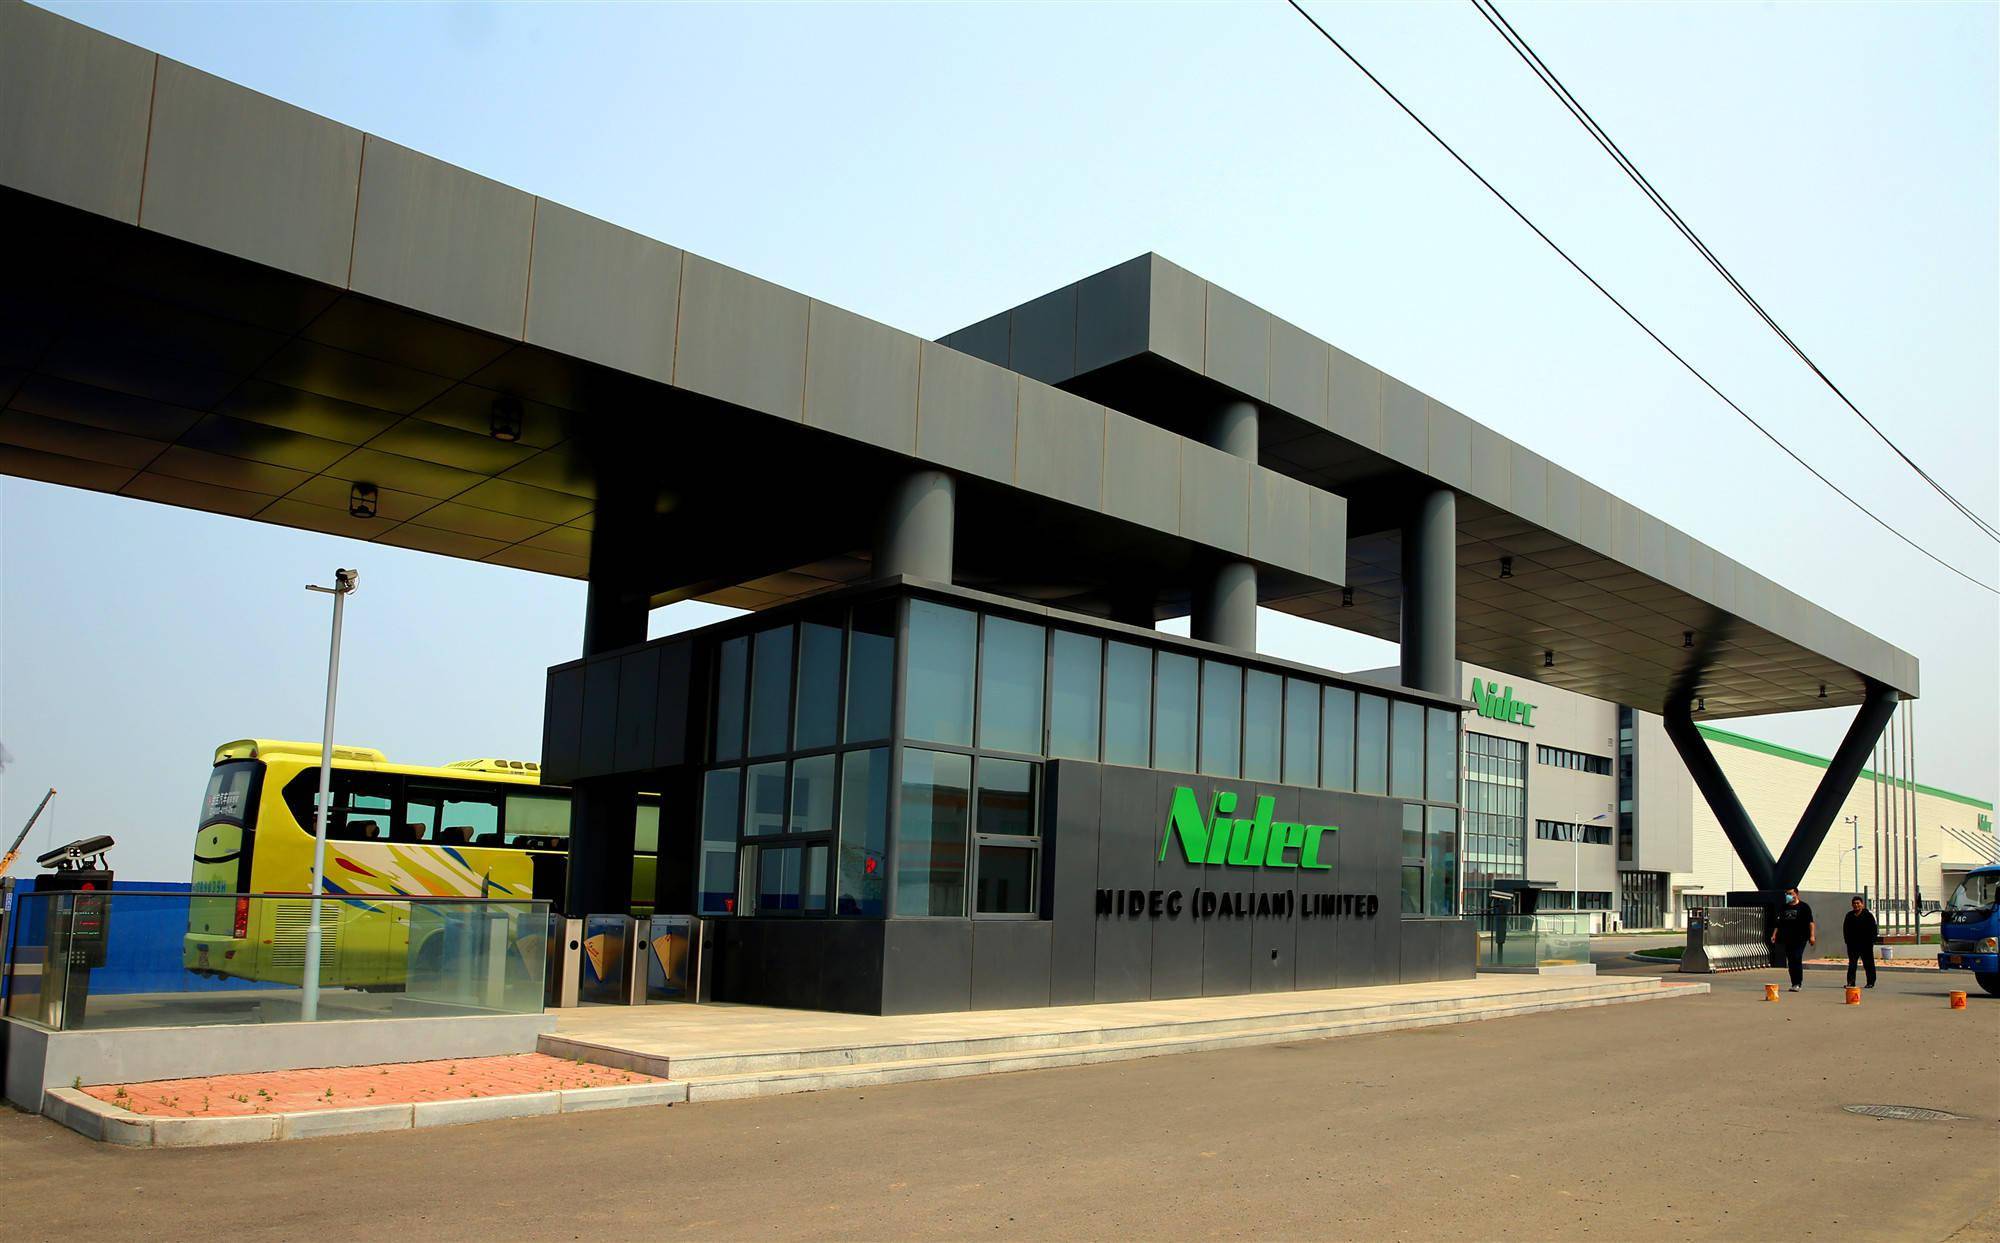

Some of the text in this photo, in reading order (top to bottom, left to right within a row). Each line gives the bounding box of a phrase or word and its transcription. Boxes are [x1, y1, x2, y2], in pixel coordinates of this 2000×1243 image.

[1469, 677, 1538, 727] Nidec
[1158, 786, 1339, 869] Nidec
[1096, 887, 1379, 918] NIDEC (DALIAN) LIMITED
